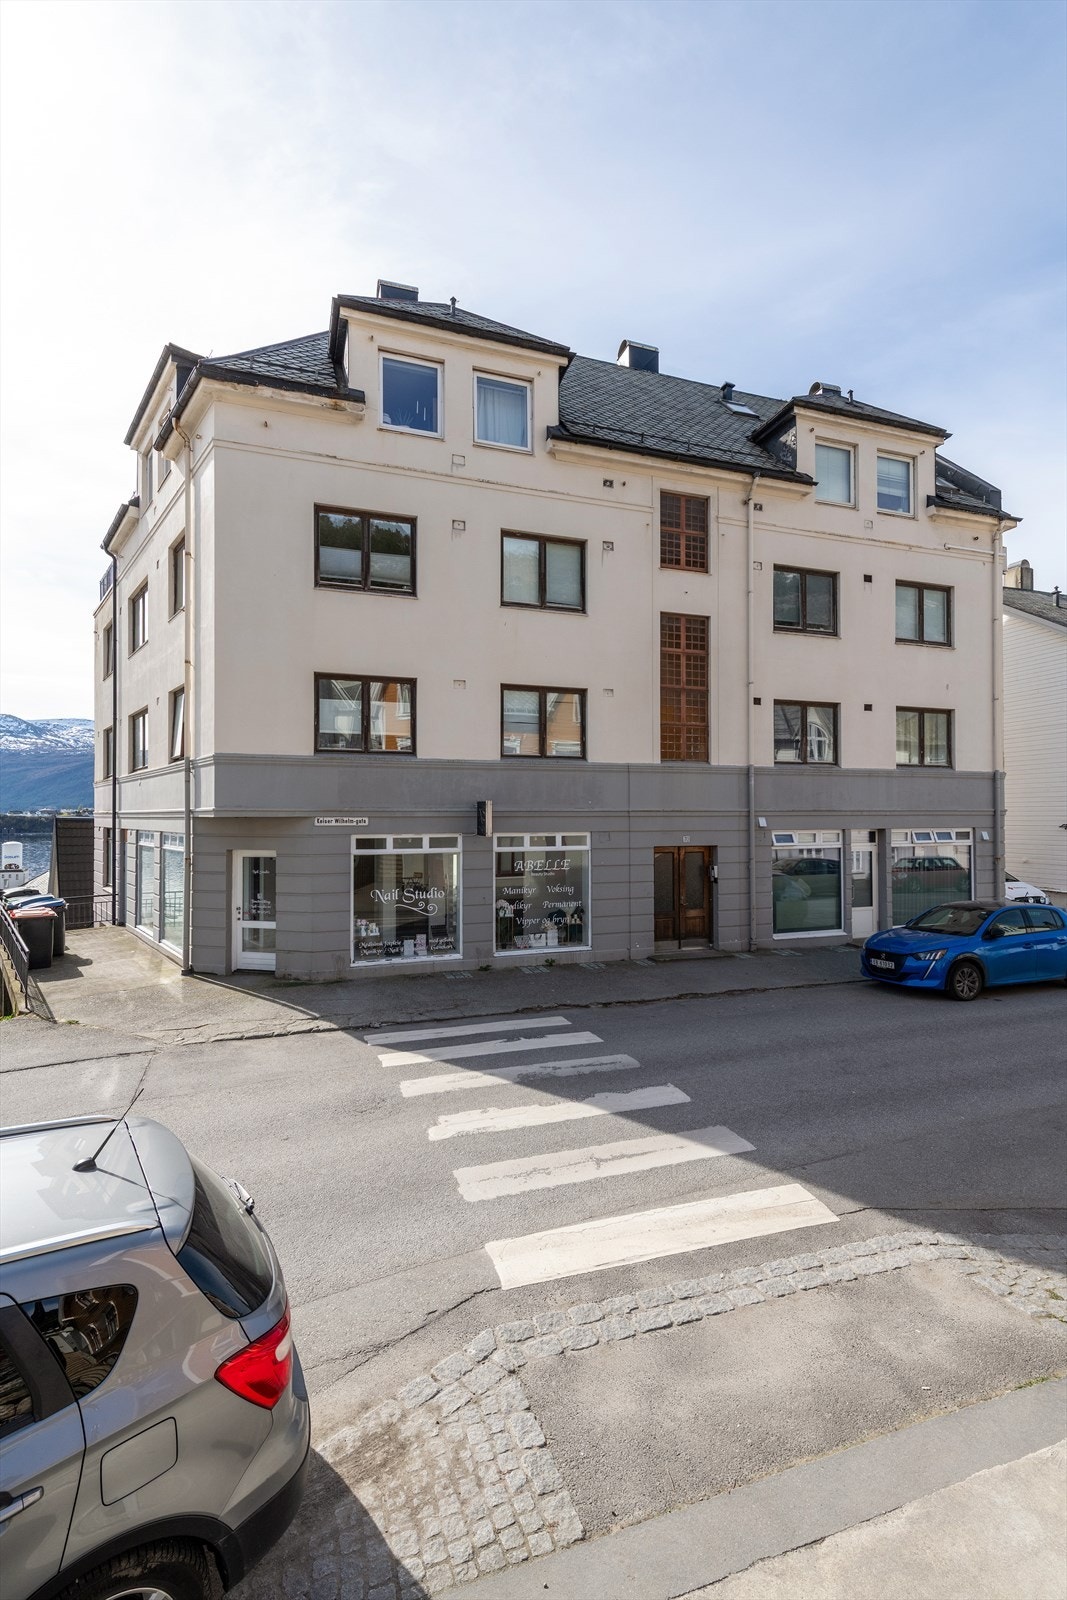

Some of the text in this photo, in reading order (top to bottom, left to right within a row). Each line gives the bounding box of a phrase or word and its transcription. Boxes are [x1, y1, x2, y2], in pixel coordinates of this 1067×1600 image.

[514, 860, 570, 871] ABELLE
[502, 887, 536, 897] Manikyr
[547, 884, 574, 895] Voksing
[370, 887, 445, 904] Nail Studio
[542, 900, 582, 909] Permanent
[516, 917, 540, 928] Vipper
[552, 913, 570, 927] bryn
